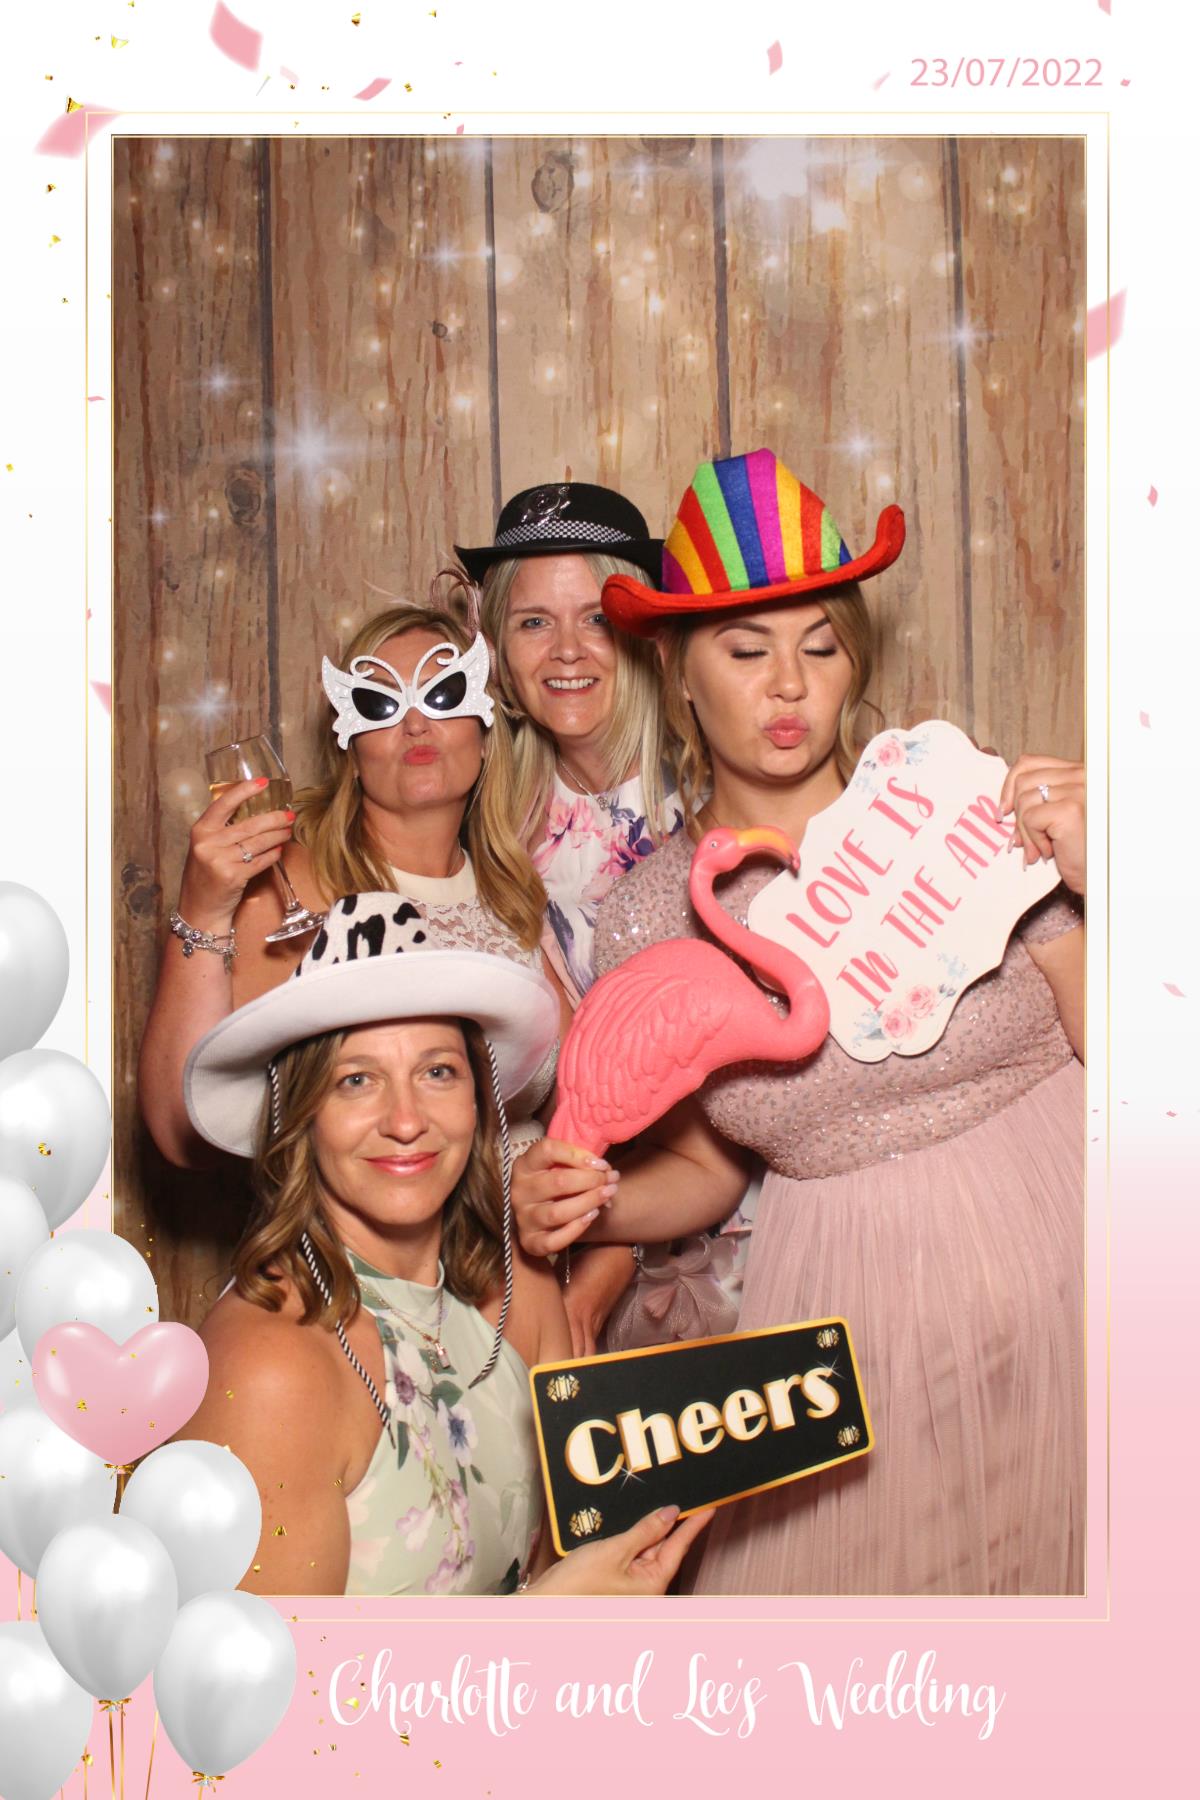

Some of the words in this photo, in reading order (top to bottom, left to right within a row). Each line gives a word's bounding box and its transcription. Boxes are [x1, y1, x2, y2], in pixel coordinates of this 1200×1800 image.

[785, 828, 894, 949] LOVE
[868, 776, 935, 840] IS
[836, 950, 899, 1012] IN
[880, 865, 963, 949] THE
[944, 794, 1016, 880] AIR
[564, 1366, 841, 1486] Cheers
